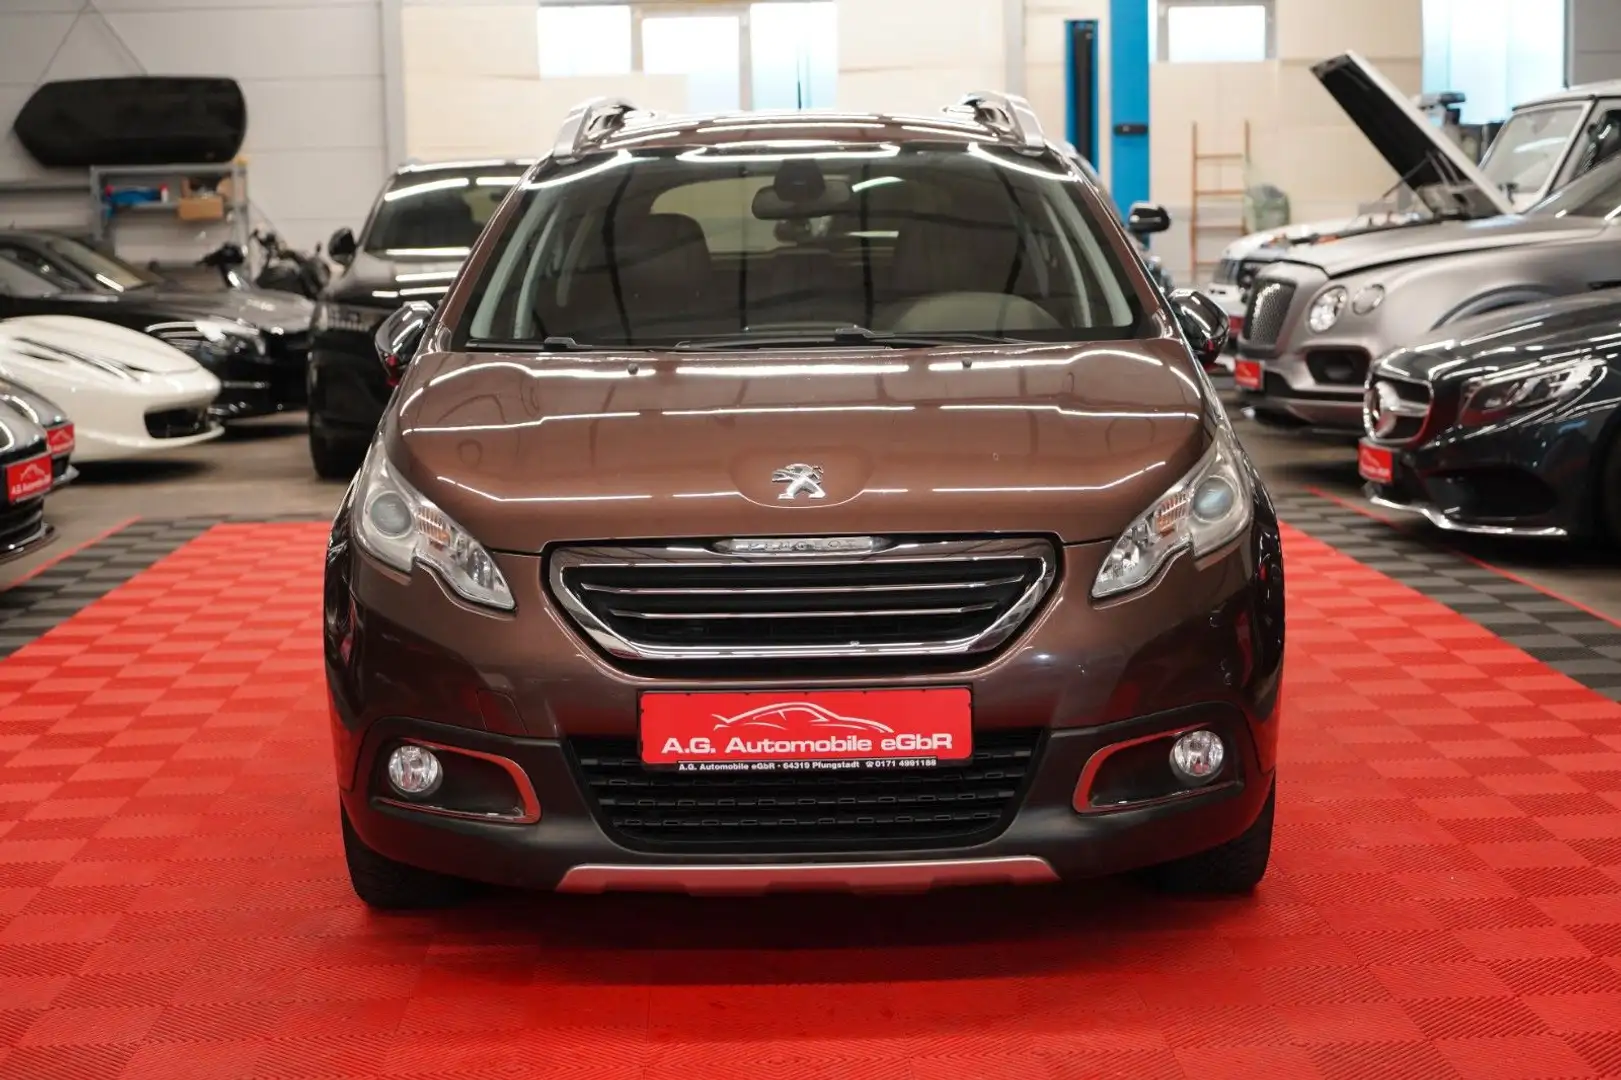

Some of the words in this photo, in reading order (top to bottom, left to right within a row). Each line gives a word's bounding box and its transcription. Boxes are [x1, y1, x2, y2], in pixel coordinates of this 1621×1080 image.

[661, 737, 716, 754] A.G.
[725, 736, 872, 753] Automobile
[880, 733, 952, 751] eGbR
[679, 763, 697, 771] A.G.
